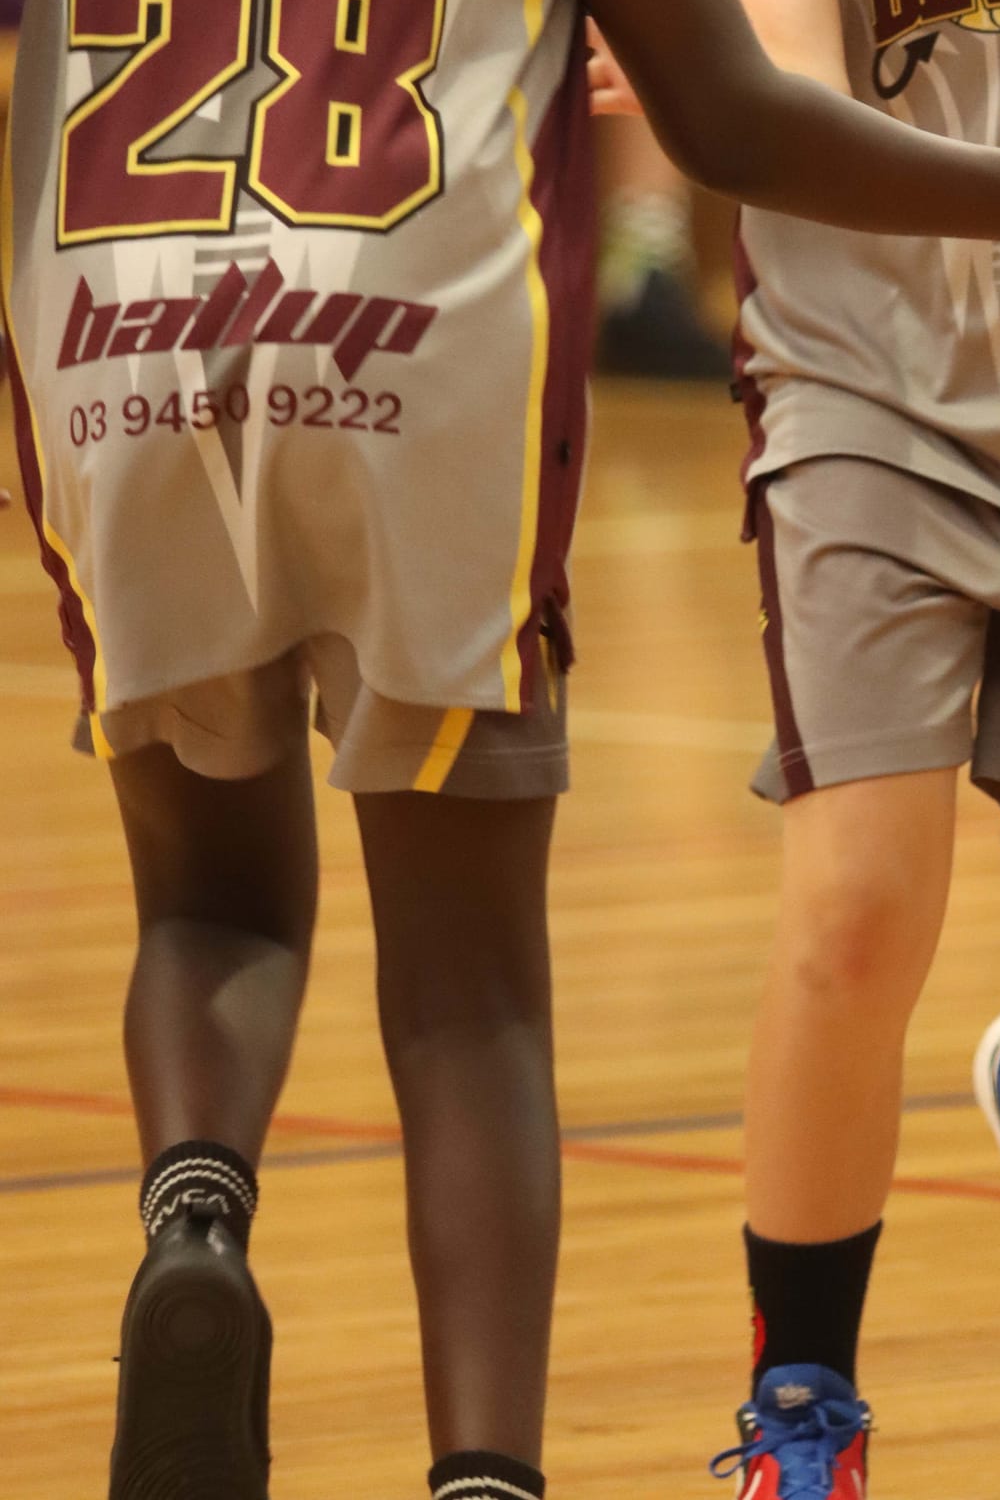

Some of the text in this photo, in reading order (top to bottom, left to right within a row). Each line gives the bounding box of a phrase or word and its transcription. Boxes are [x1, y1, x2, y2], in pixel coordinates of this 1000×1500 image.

[56, 256, 439, 383] ballup
[69, 385, 401, 448] 03 9450 9222
